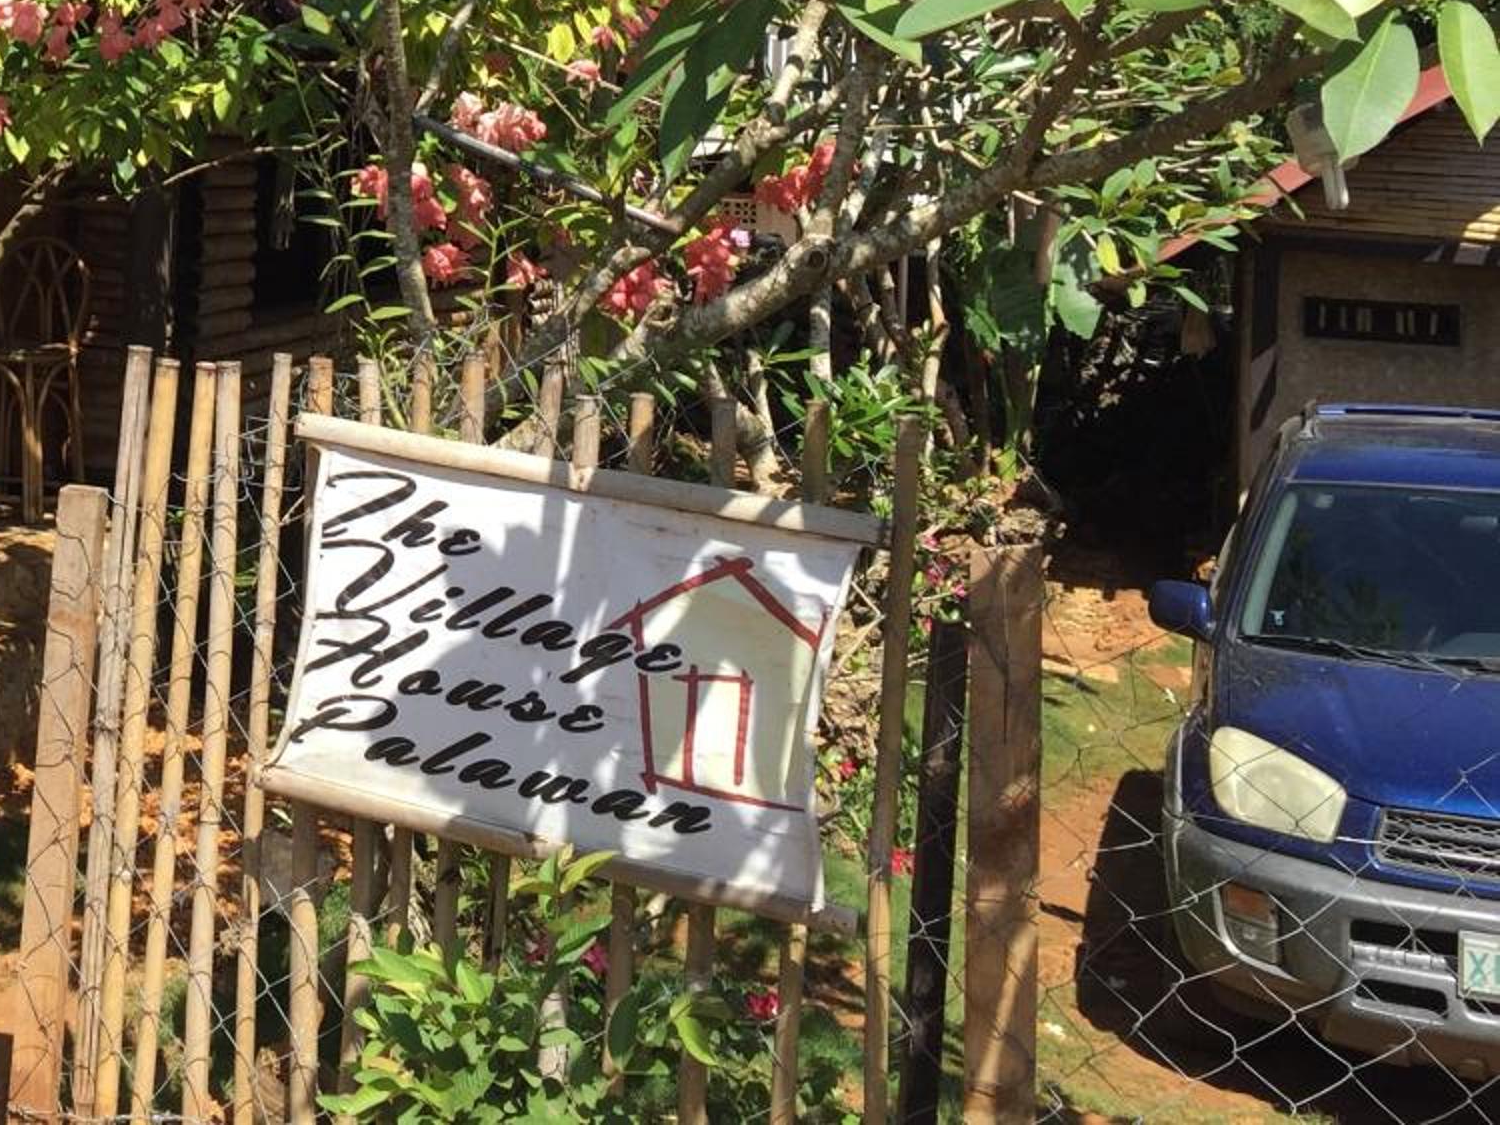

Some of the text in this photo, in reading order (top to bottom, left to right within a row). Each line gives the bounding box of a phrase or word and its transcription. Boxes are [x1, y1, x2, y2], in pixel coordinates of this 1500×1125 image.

[322, 471, 481, 556] The
[304, 612, 604, 733] House
[320, 539, 683, 683] Village
[290, 695, 712, 834] Palawan
